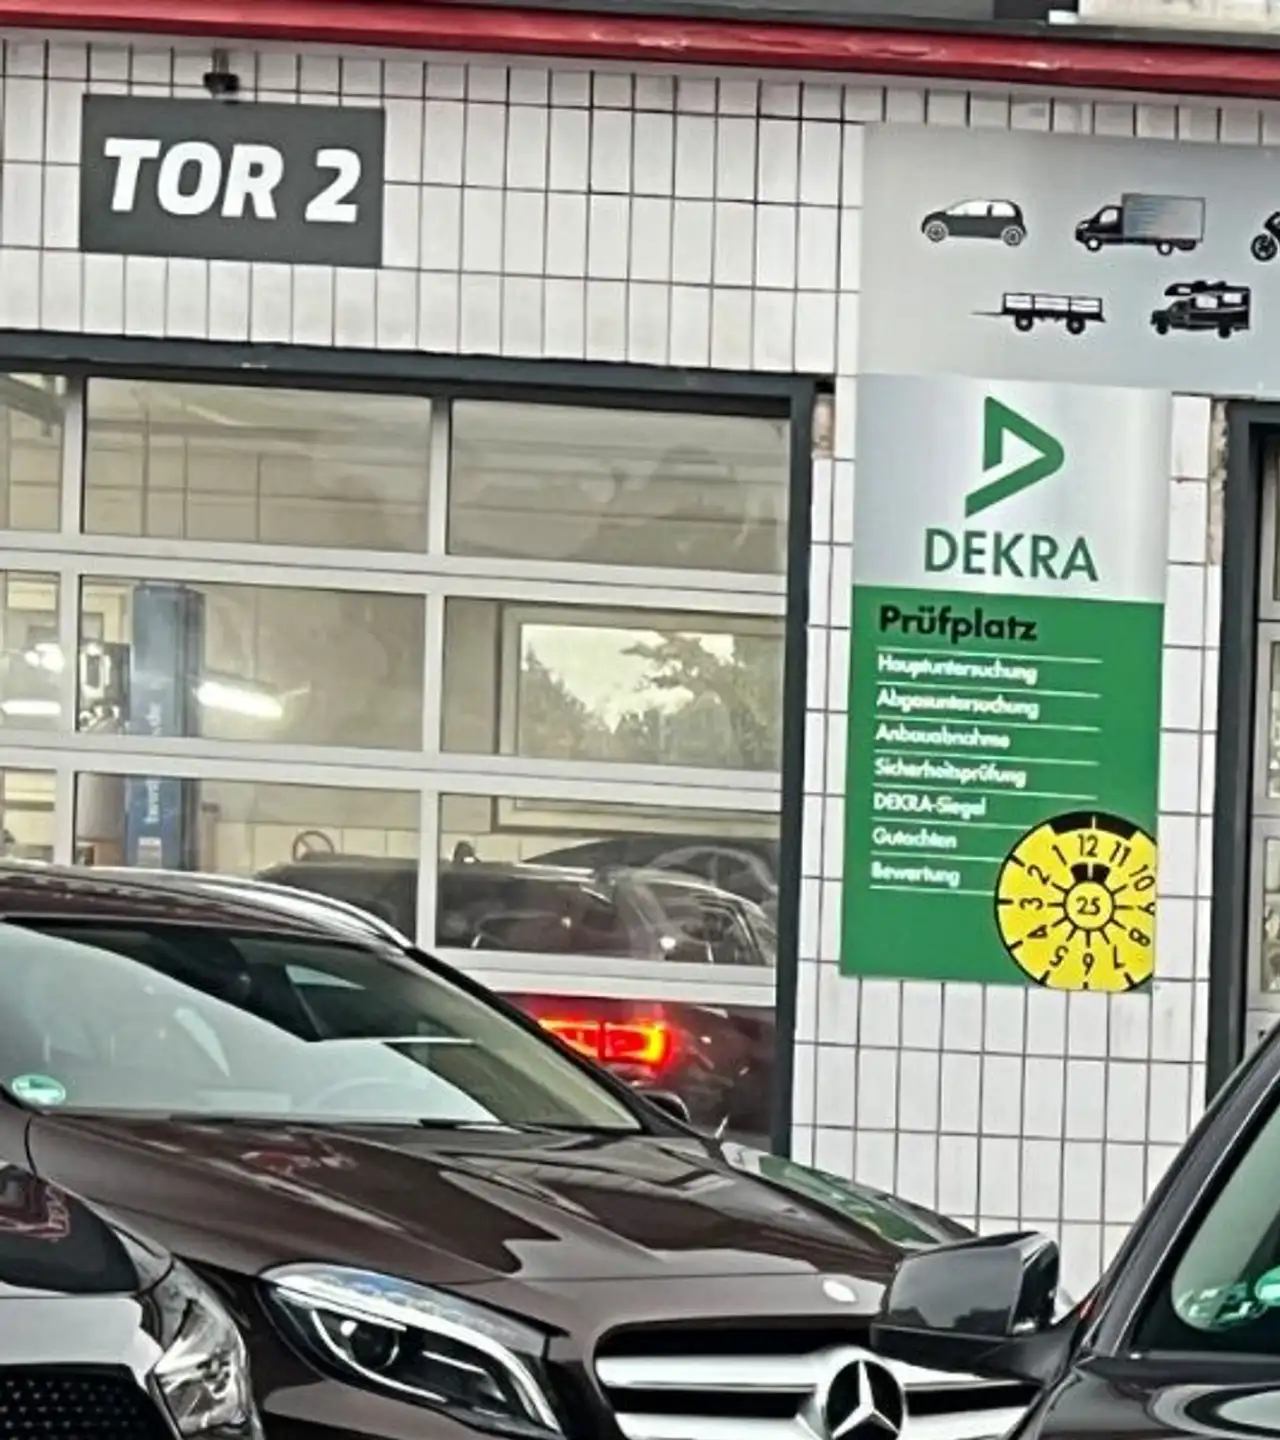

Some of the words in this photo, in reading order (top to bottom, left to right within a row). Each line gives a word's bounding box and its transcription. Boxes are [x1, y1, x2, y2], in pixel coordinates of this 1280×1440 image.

[104, 137, 285, 220] TOR
[304, 148, 361, 223] 2
[924, 528, 1099, 582] DEKRA
[879, 604, 1038, 644] Prüfplatz
[877, 653, 1038, 685] Hauptuntersuchung
[876, 688, 1040, 720] Abgasuntersuchung
[875, 723, 1010, 749] Anbauabnahme
[874, 757, 1027, 788] Sicherheitsprüfung
[873, 791, 987, 820] DEKRA-Siegel
[872, 827, 957, 849] Gutachten
[1077, 833, 1098, 858] 12
[1052, 844, 1067, 865] 1
[1109, 841, 1132, 867] 11
[871, 861, 960, 887] Bewertung
[1027, 864, 1050, 885] 2
[1129, 864, 1155, 892] 10
[1019, 897, 1045, 910] 3
[1075, 896, 1101, 916] 25
[1027, 924, 1048, 939] 4
[1128, 927, 1151, 947] 8
[1049, 945, 1069, 967] 5
